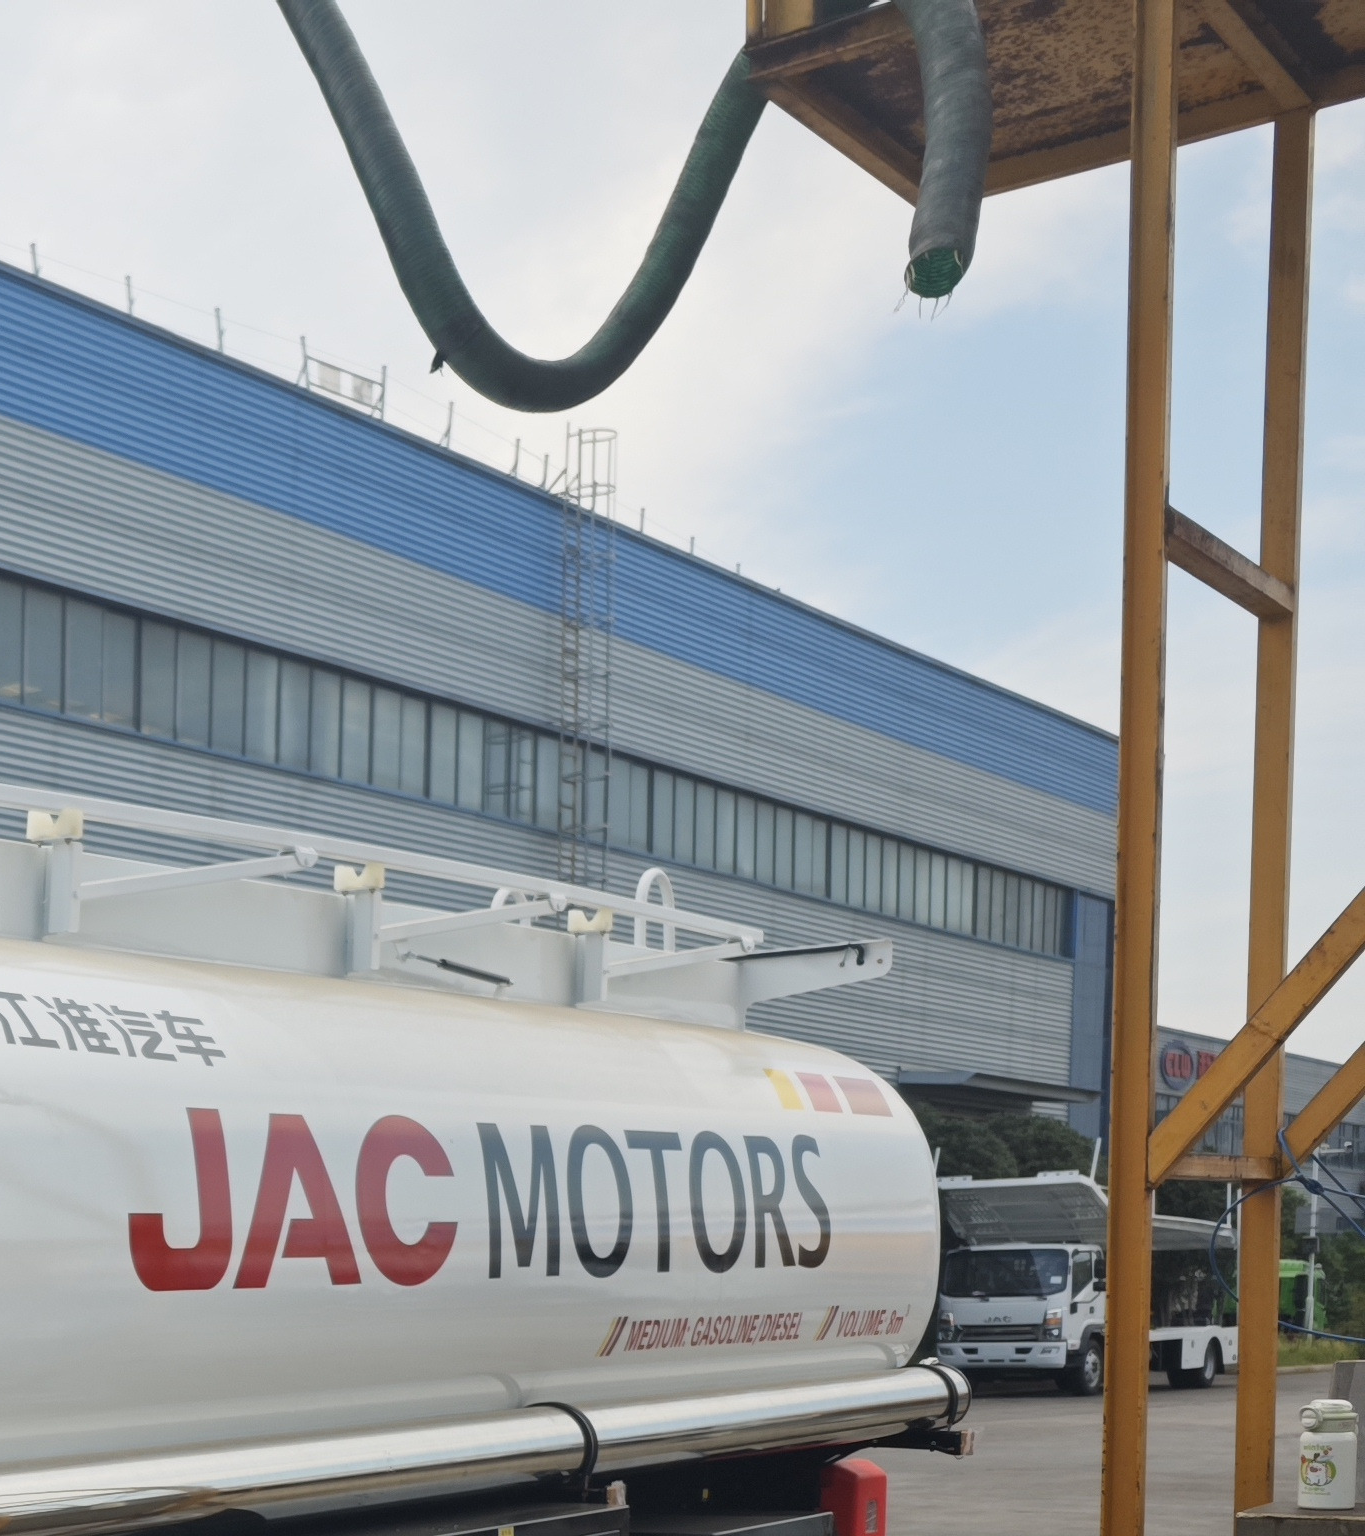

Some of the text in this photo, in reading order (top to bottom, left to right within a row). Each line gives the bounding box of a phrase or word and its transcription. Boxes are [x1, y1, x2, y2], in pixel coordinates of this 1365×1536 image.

[127, 1106, 832, 1292] JAC MOTORS
[623, 1311, 804, 1352] MEDIUM: GASOLINE/DIESEL
[835, 1309, 887, 1338] VOLUME:
[983, 1315, 1012, 1324] JAC
